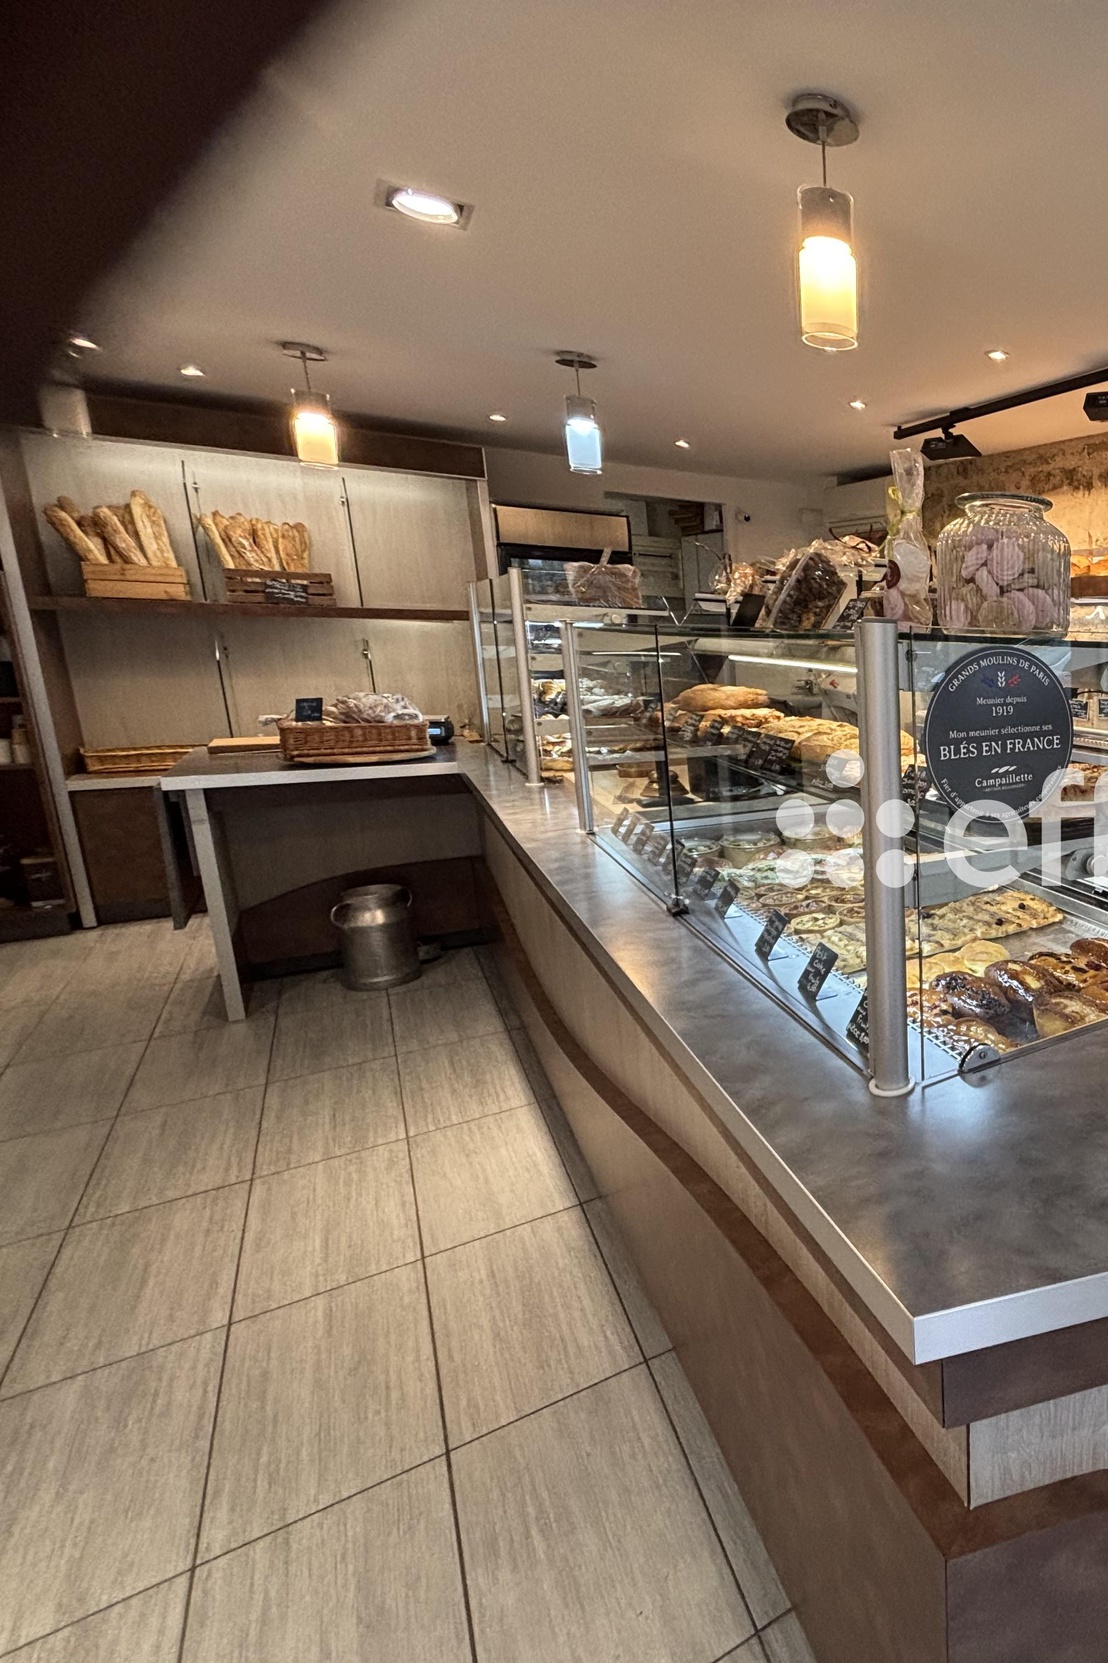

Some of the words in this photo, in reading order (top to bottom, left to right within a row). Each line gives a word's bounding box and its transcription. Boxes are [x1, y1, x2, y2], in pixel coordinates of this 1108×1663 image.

[948, 663, 980, 692] GRANDS
[979, 655, 1018, 668] MOULINS
[1018, 660, 1031, 670] DE
[1030, 664, 1051, 686] PARIS
[976, 697, 1004, 705] Meunier
[1005, 695, 1027, 705] depuis
[992, 705, 1014, 716] 1919
[949, 730, 967, 739] Mon
[969, 728, 999, 737] meunier
[1001, 724, 1040, 735] sélectionne
[940, 741, 978, 760] BLÉS
[982, 741, 1002, 756] EN
[1006, 735, 1061, 754] FRANCE
[940, 778, 951, 794] Fier
[975, 773, 1033, 788] Campaillette
